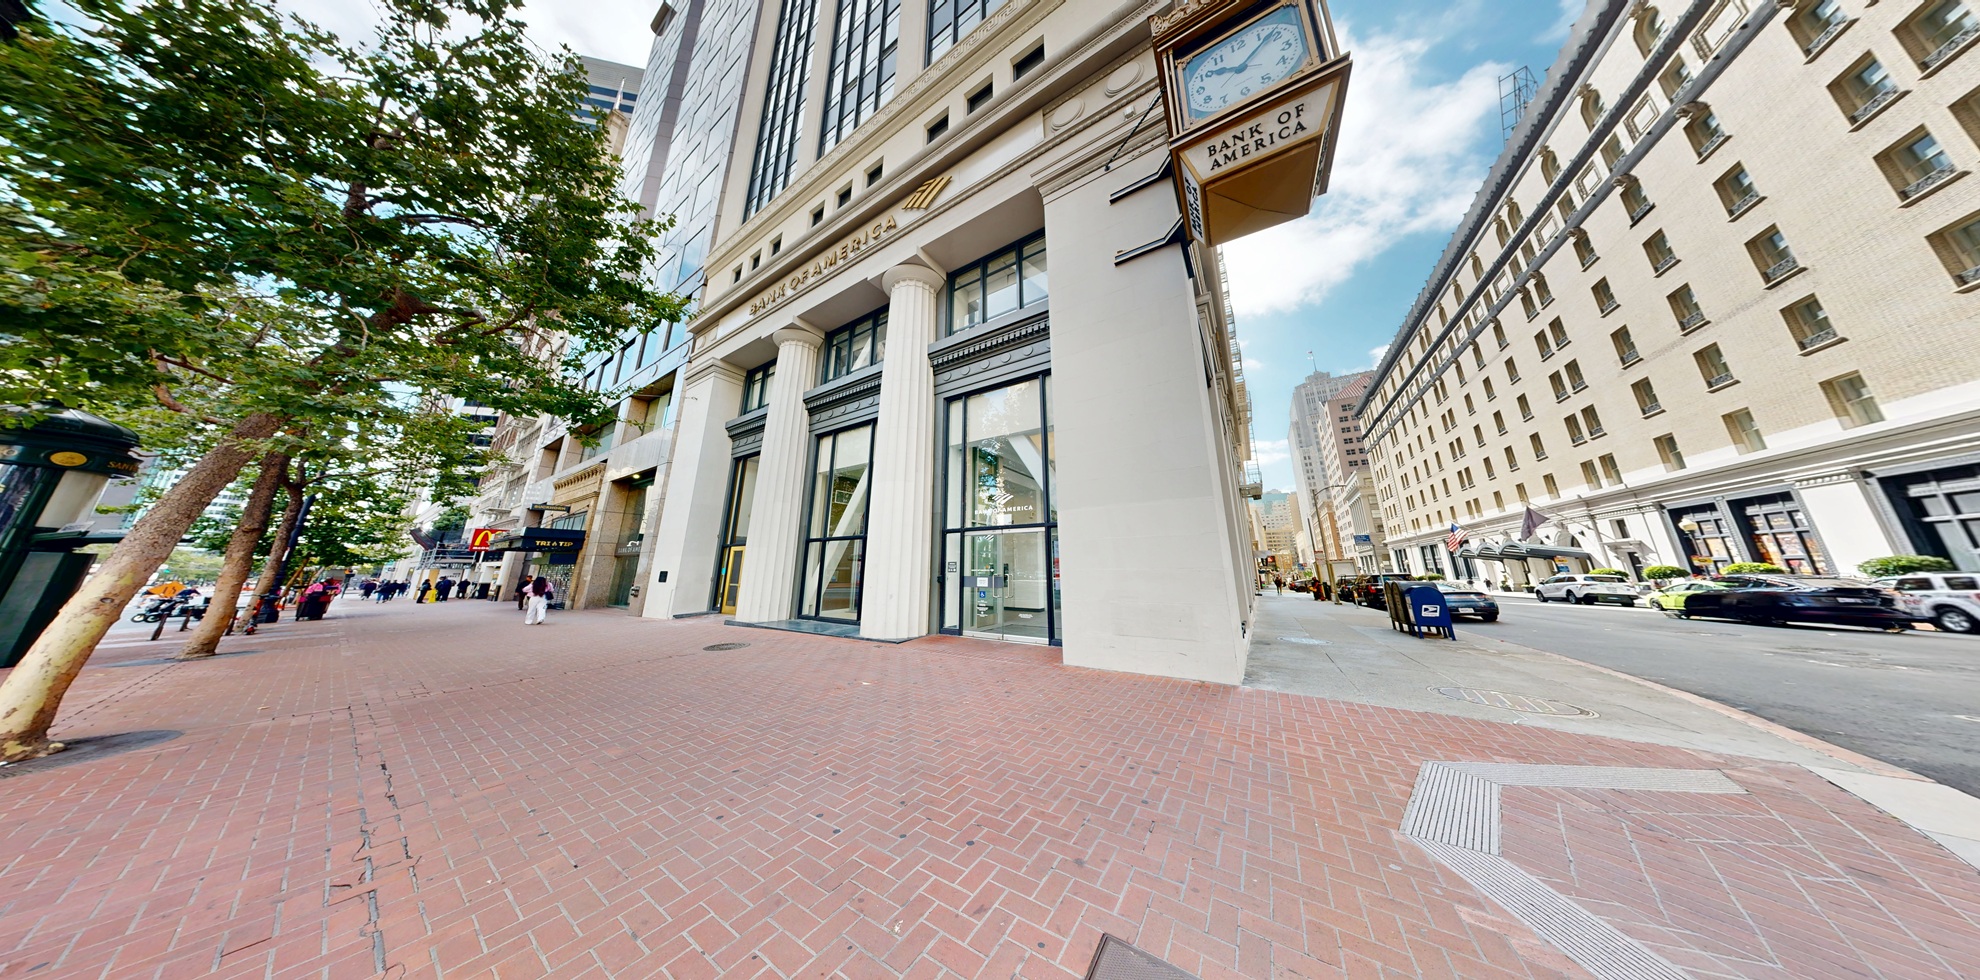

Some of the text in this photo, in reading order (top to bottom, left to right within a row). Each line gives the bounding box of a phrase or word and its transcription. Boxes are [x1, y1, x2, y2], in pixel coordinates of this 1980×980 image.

[1256, 33, 1262, 42] 1
[1273, 30, 1282, 41] 2
[1230, 39, 1247, 53] 12
[1282, 39, 1293, 51] 3
[1213, 54, 1225, 66] 11
[1275, 55, 1289, 66] 4
[1260, 73, 1272, 85] 5
[1196, 86, 1206, 95] 9
[1240, 86, 1251, 97] 6
[1203, 95, 1213, 105] 8
[1219, 94, 1229, 104] 7
[1207, 103, 1306, 158] BANK OF
[1210, 121, 1307, 171] AMERICA
[1184, 176, 1192, 195] OF
[749, 214, 897, 316] BANK OF AMERICA
[1003, 504, 1033, 512] AMERICA
